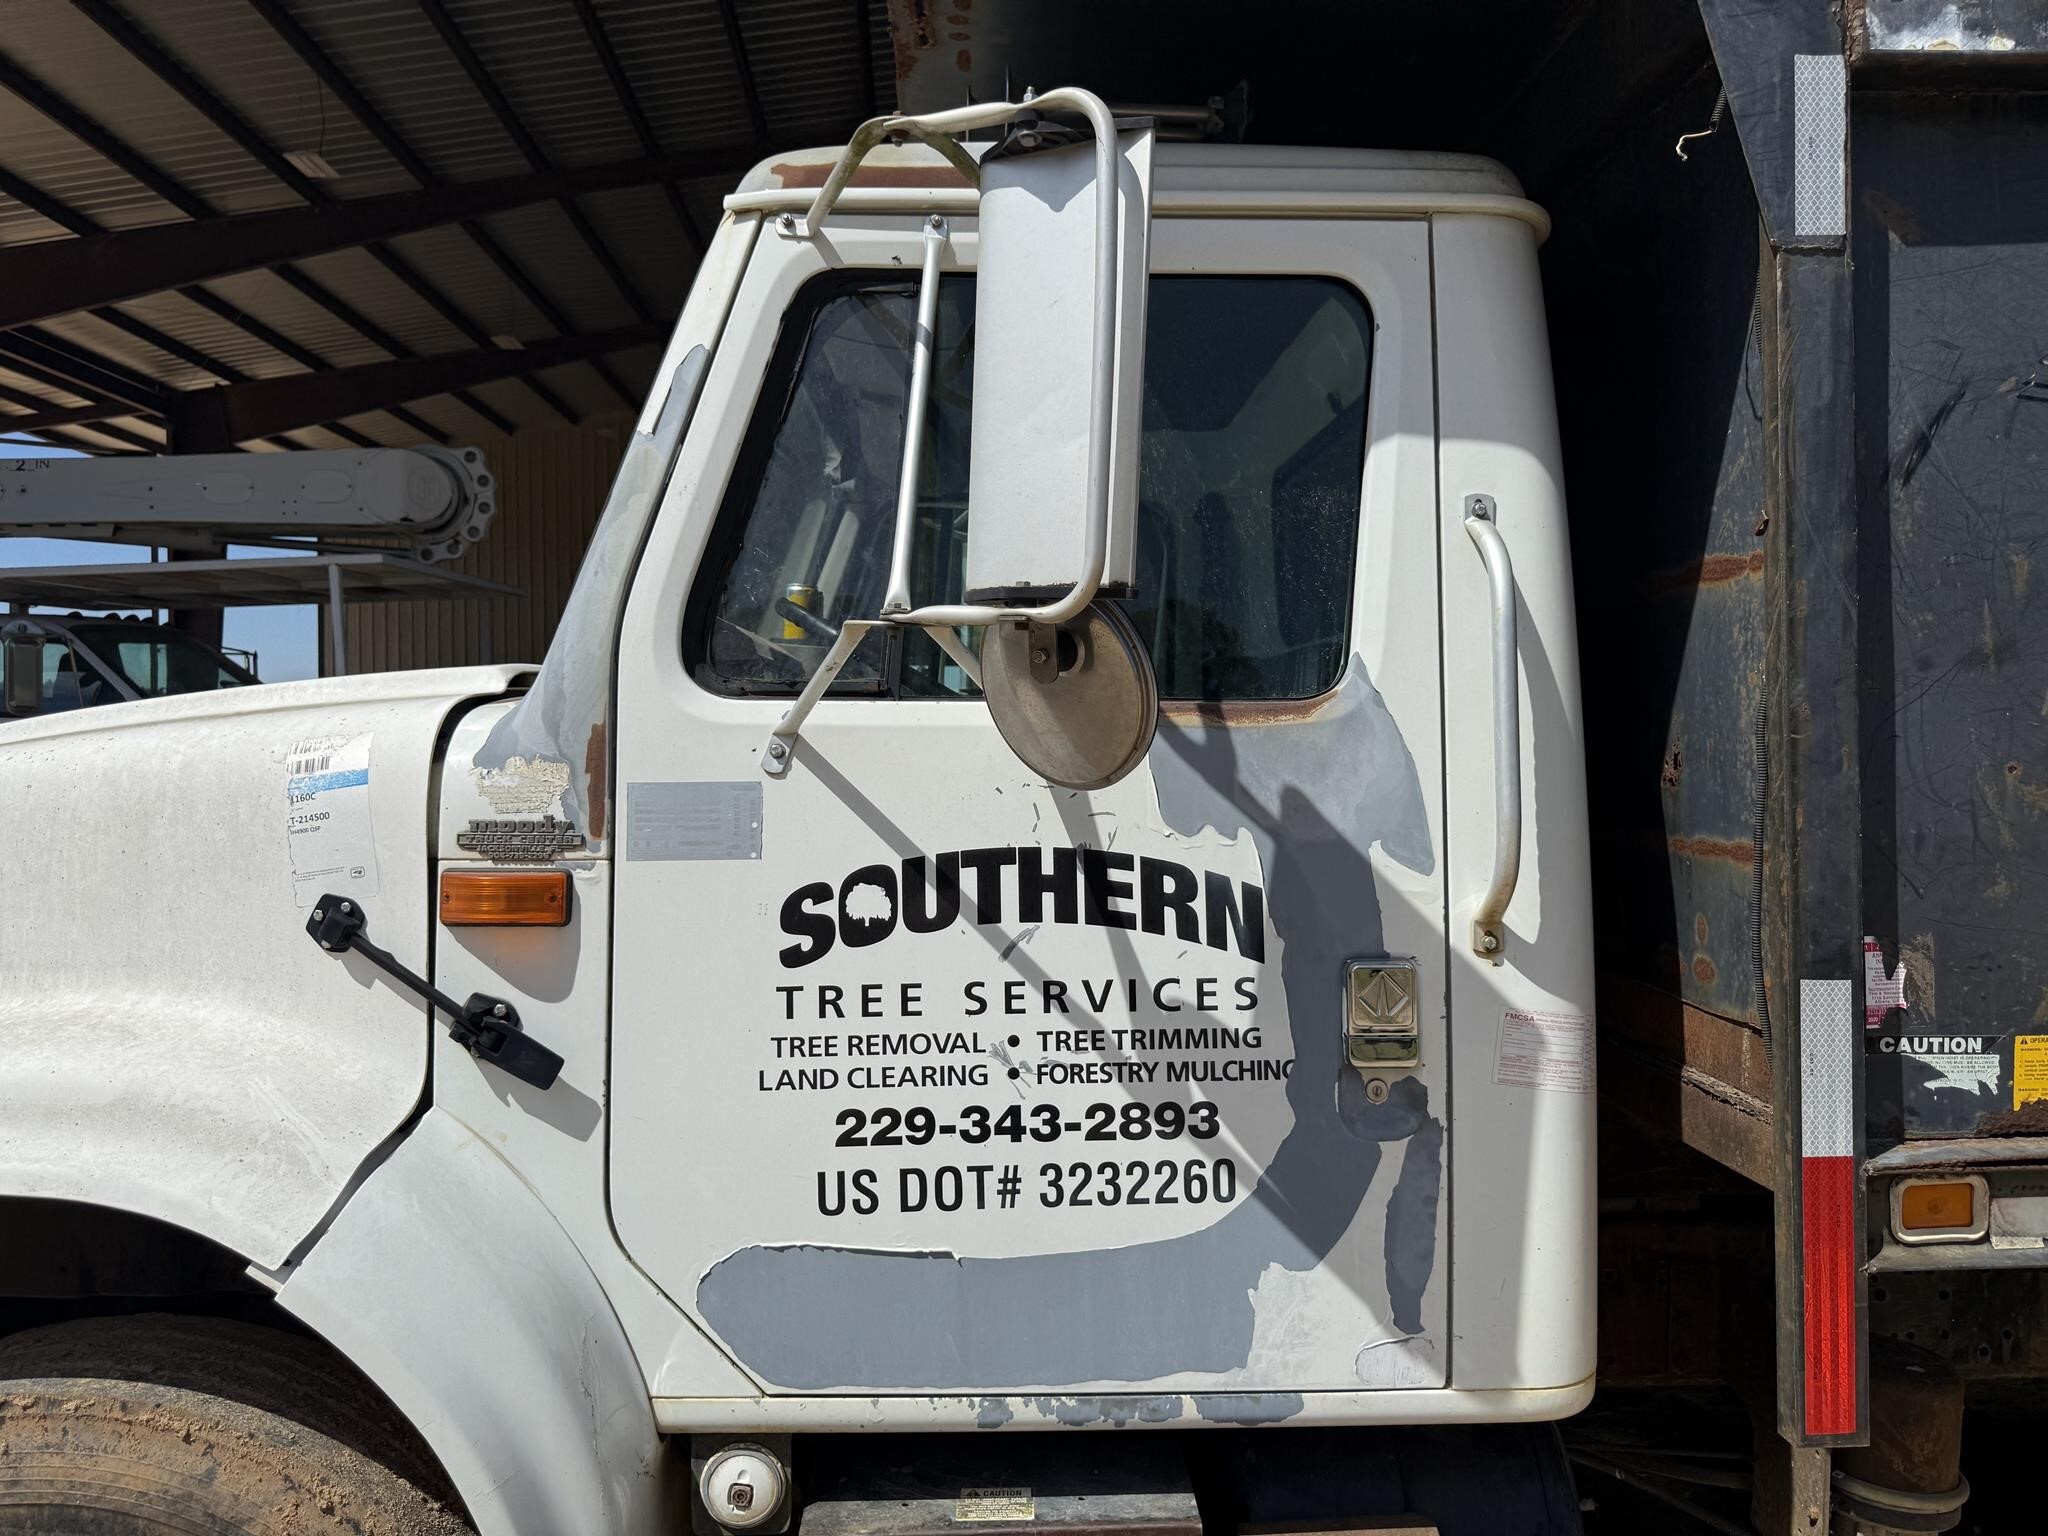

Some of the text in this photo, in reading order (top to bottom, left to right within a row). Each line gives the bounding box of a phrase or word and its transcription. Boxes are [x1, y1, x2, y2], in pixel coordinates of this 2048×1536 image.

[465, 834, 574, 844] TRUCK CENTER
[779, 846, 1266, 969] SOUTHERN
[776, 977, 1258, 1020] TREE SERVICES
[1505, 1012, 1535, 1023] FMCSA
[770, 1027, 1262, 1058] TREE REMOVAL TREE TRIMMING
[1879, 1036, 1983, 1054] CAUTION
[759, 1068, 839, 1091] LAND
[847, 1064, 988, 1089] CLEARING
[1037, 1061, 1160, 1085] FORESTRY
[835, 1101, 1220, 1148] 229-343-2893
[817, 1158, 1236, 1216] US DOT# 3232260
[983, 1489, 1022, 1497] CAUTION
